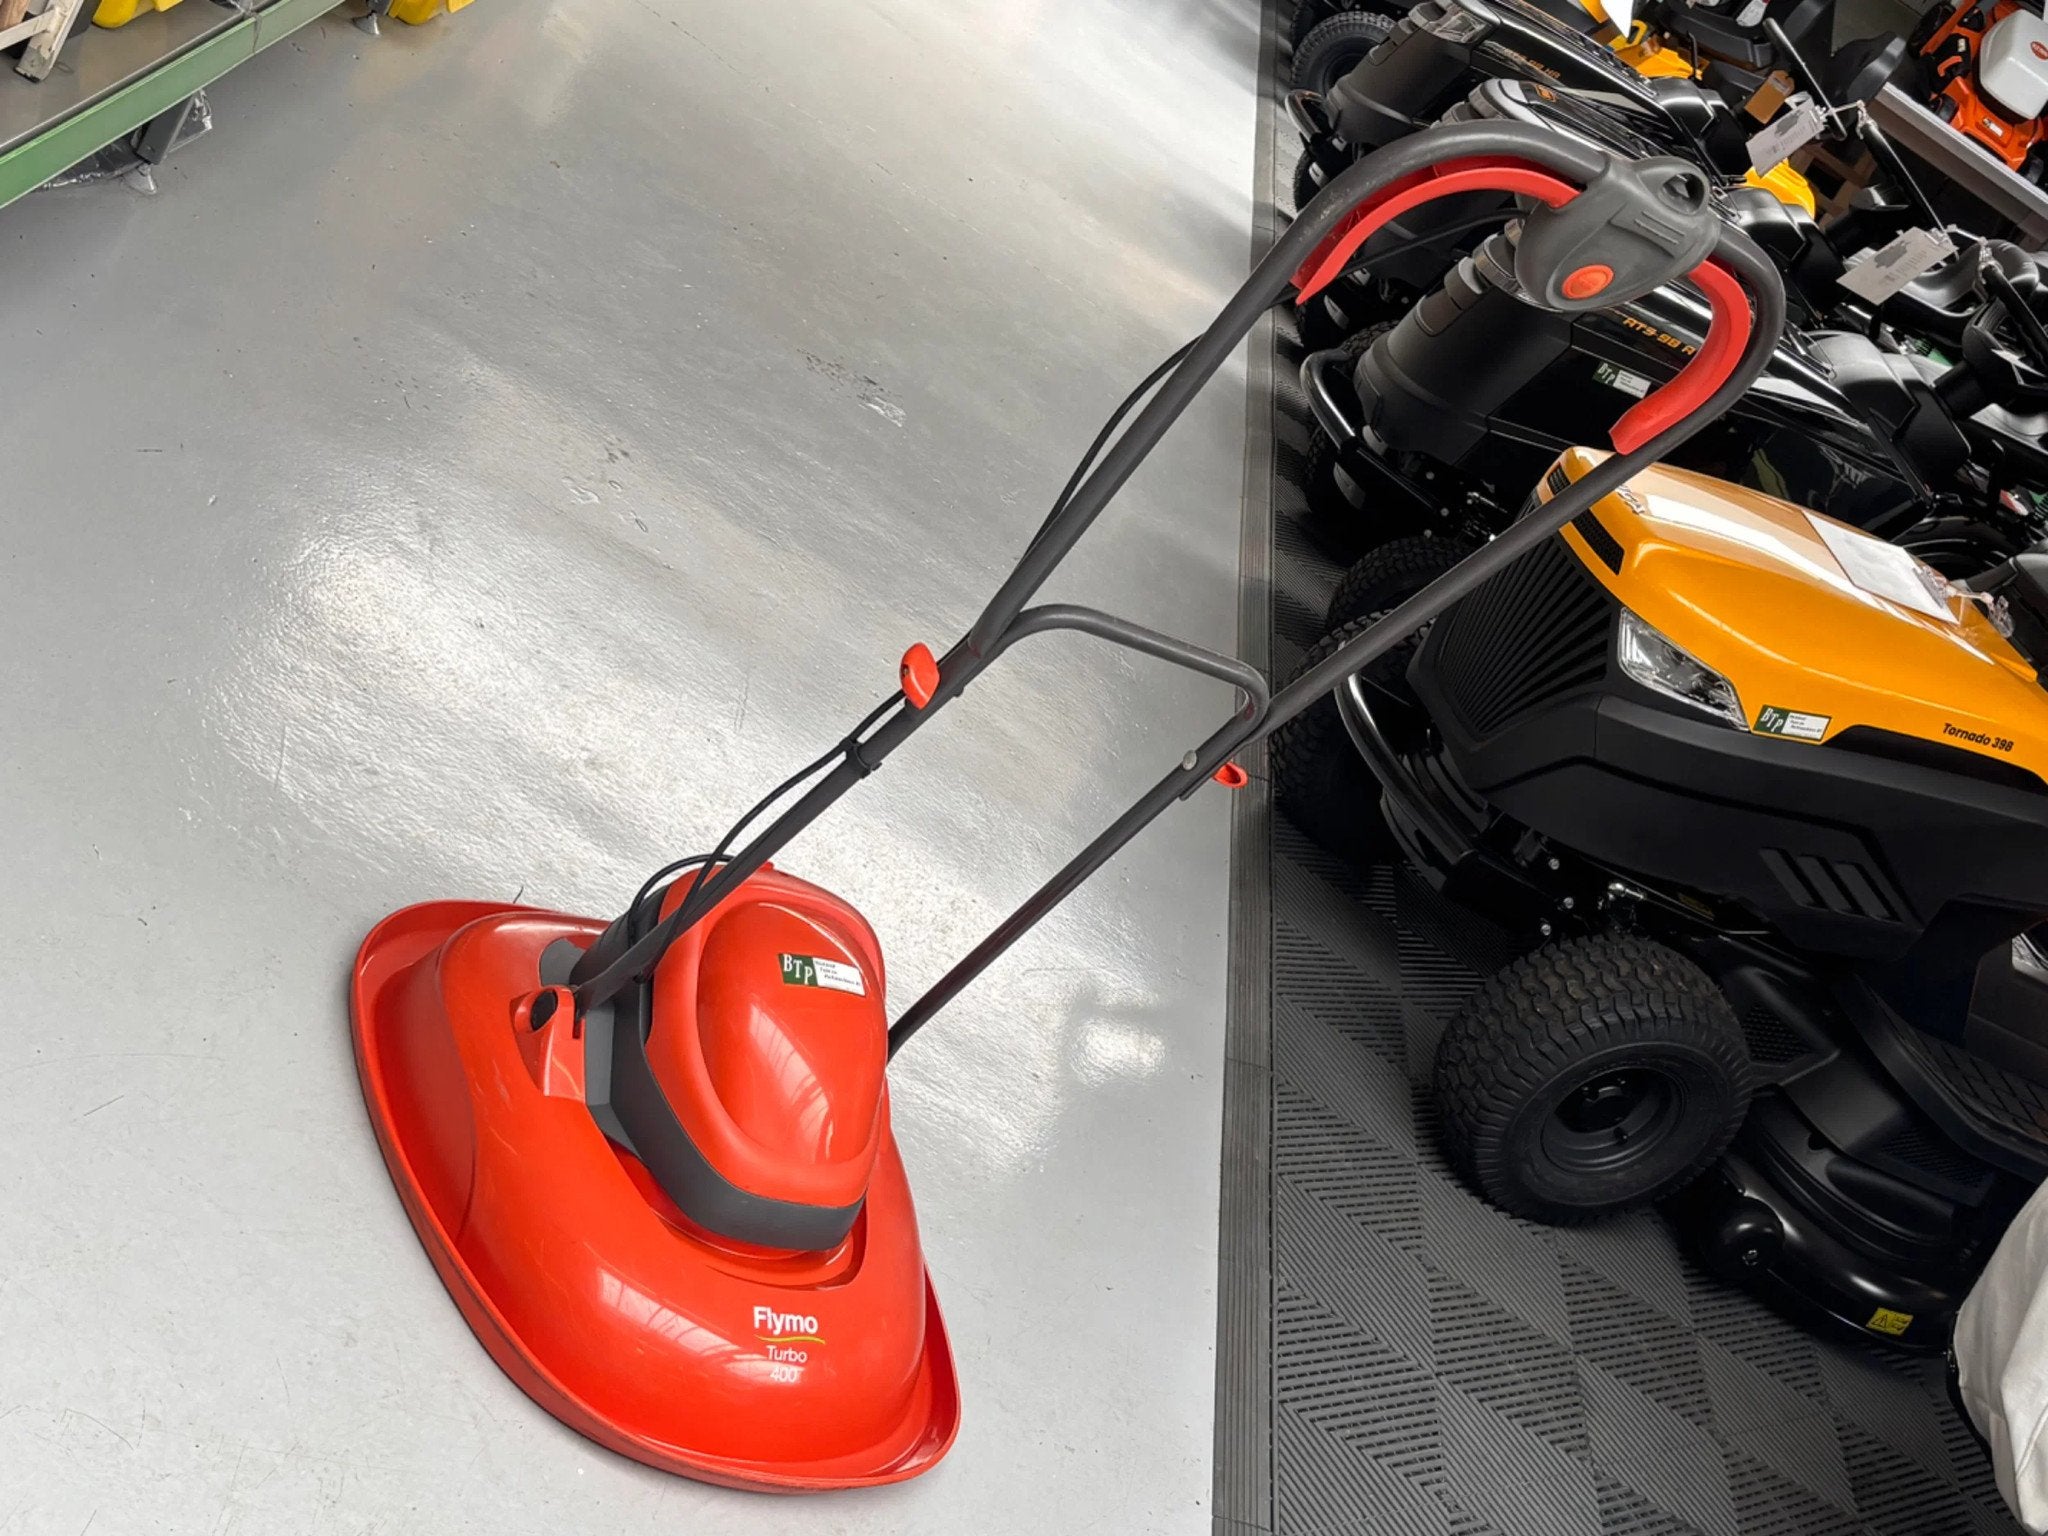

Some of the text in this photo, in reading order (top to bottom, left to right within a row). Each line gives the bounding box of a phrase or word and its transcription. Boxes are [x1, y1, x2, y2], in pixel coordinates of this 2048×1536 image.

[1597, 362, 1616, 385] BTP
[1760, 707, 1784, 733] BTP
[1943, 722, 2015, 752] Tornado 398
[783, 954, 813, 985] BTP
[753, 1305, 819, 1335] Flymo
[766, 1345, 808, 1363] Turbo
[770, 1366, 798, 1383] 400
